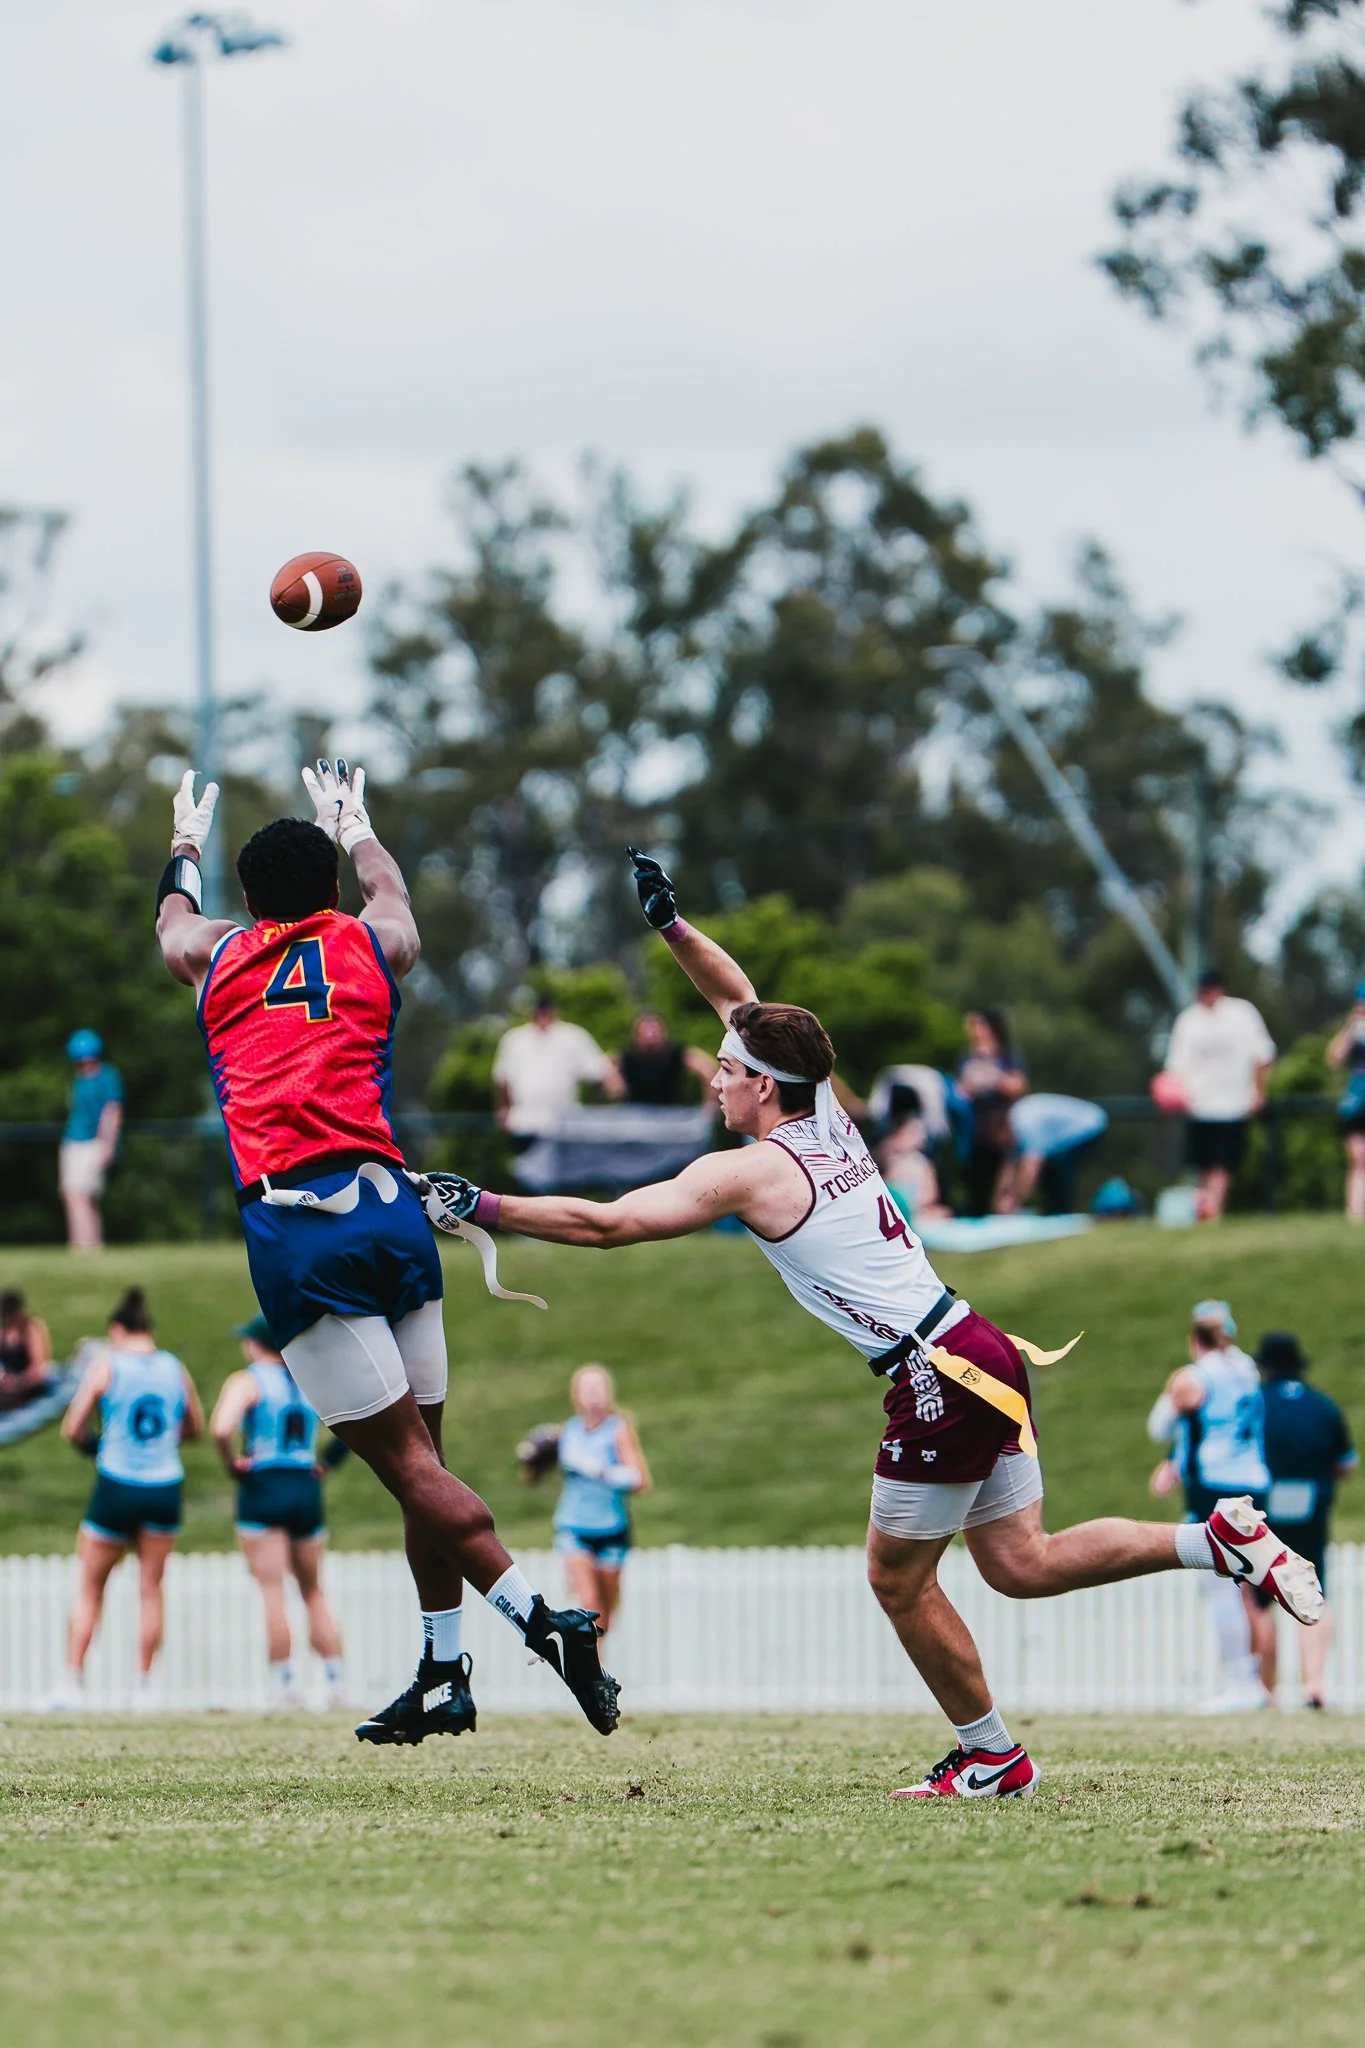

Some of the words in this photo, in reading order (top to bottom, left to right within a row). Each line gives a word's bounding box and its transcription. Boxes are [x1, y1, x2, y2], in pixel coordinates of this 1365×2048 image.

[262, 936, 336, 1023] 4
[877, 1194, 914, 1249] 4
[129, 1394, 169, 1442] 6
[423, 1682, 452, 1713] NIKE
